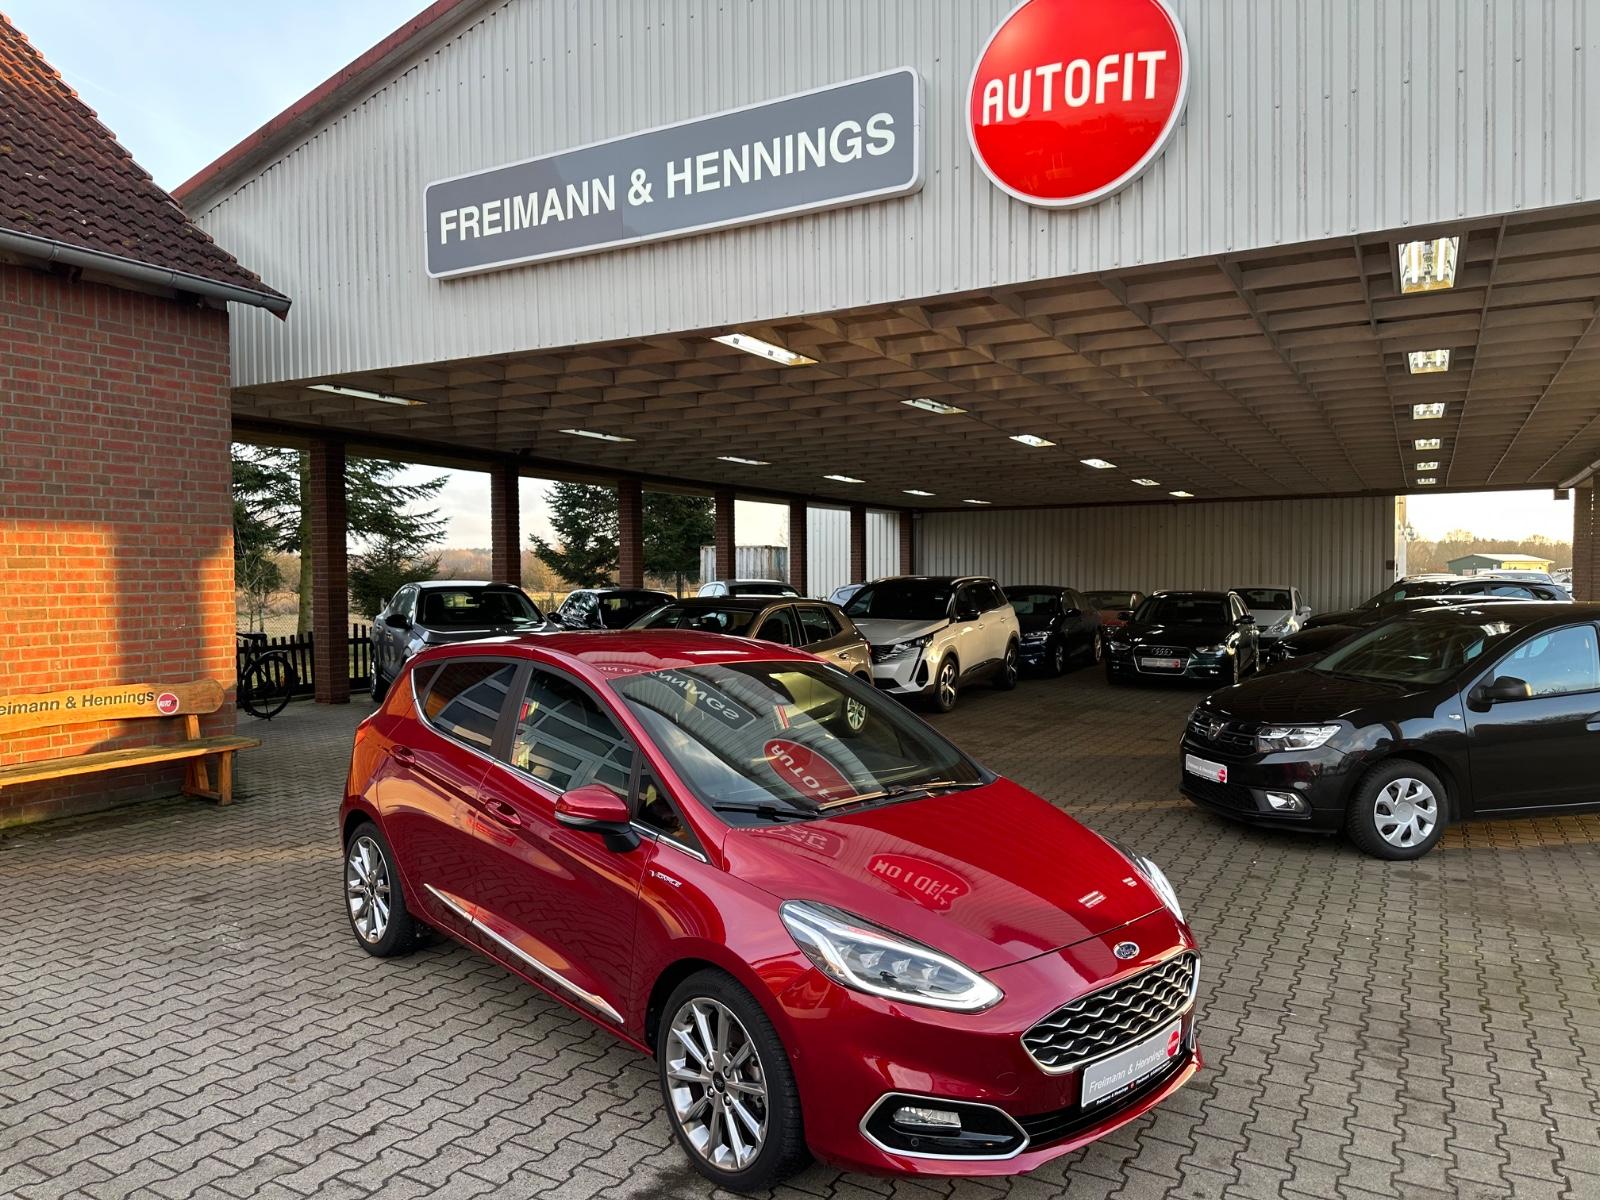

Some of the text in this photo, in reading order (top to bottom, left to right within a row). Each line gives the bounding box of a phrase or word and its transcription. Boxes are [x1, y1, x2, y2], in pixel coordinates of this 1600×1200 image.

[982, 50, 1167, 127] AUTOFIT
[440, 112, 896, 245] FREIMANN & HENNINGS
[65, 696, 77, 709] &
[81, 692, 155, 707] Hennings
[1089, 1070, 1126, 1094] Freimann
[1127, 1064, 1133, 1075] &
